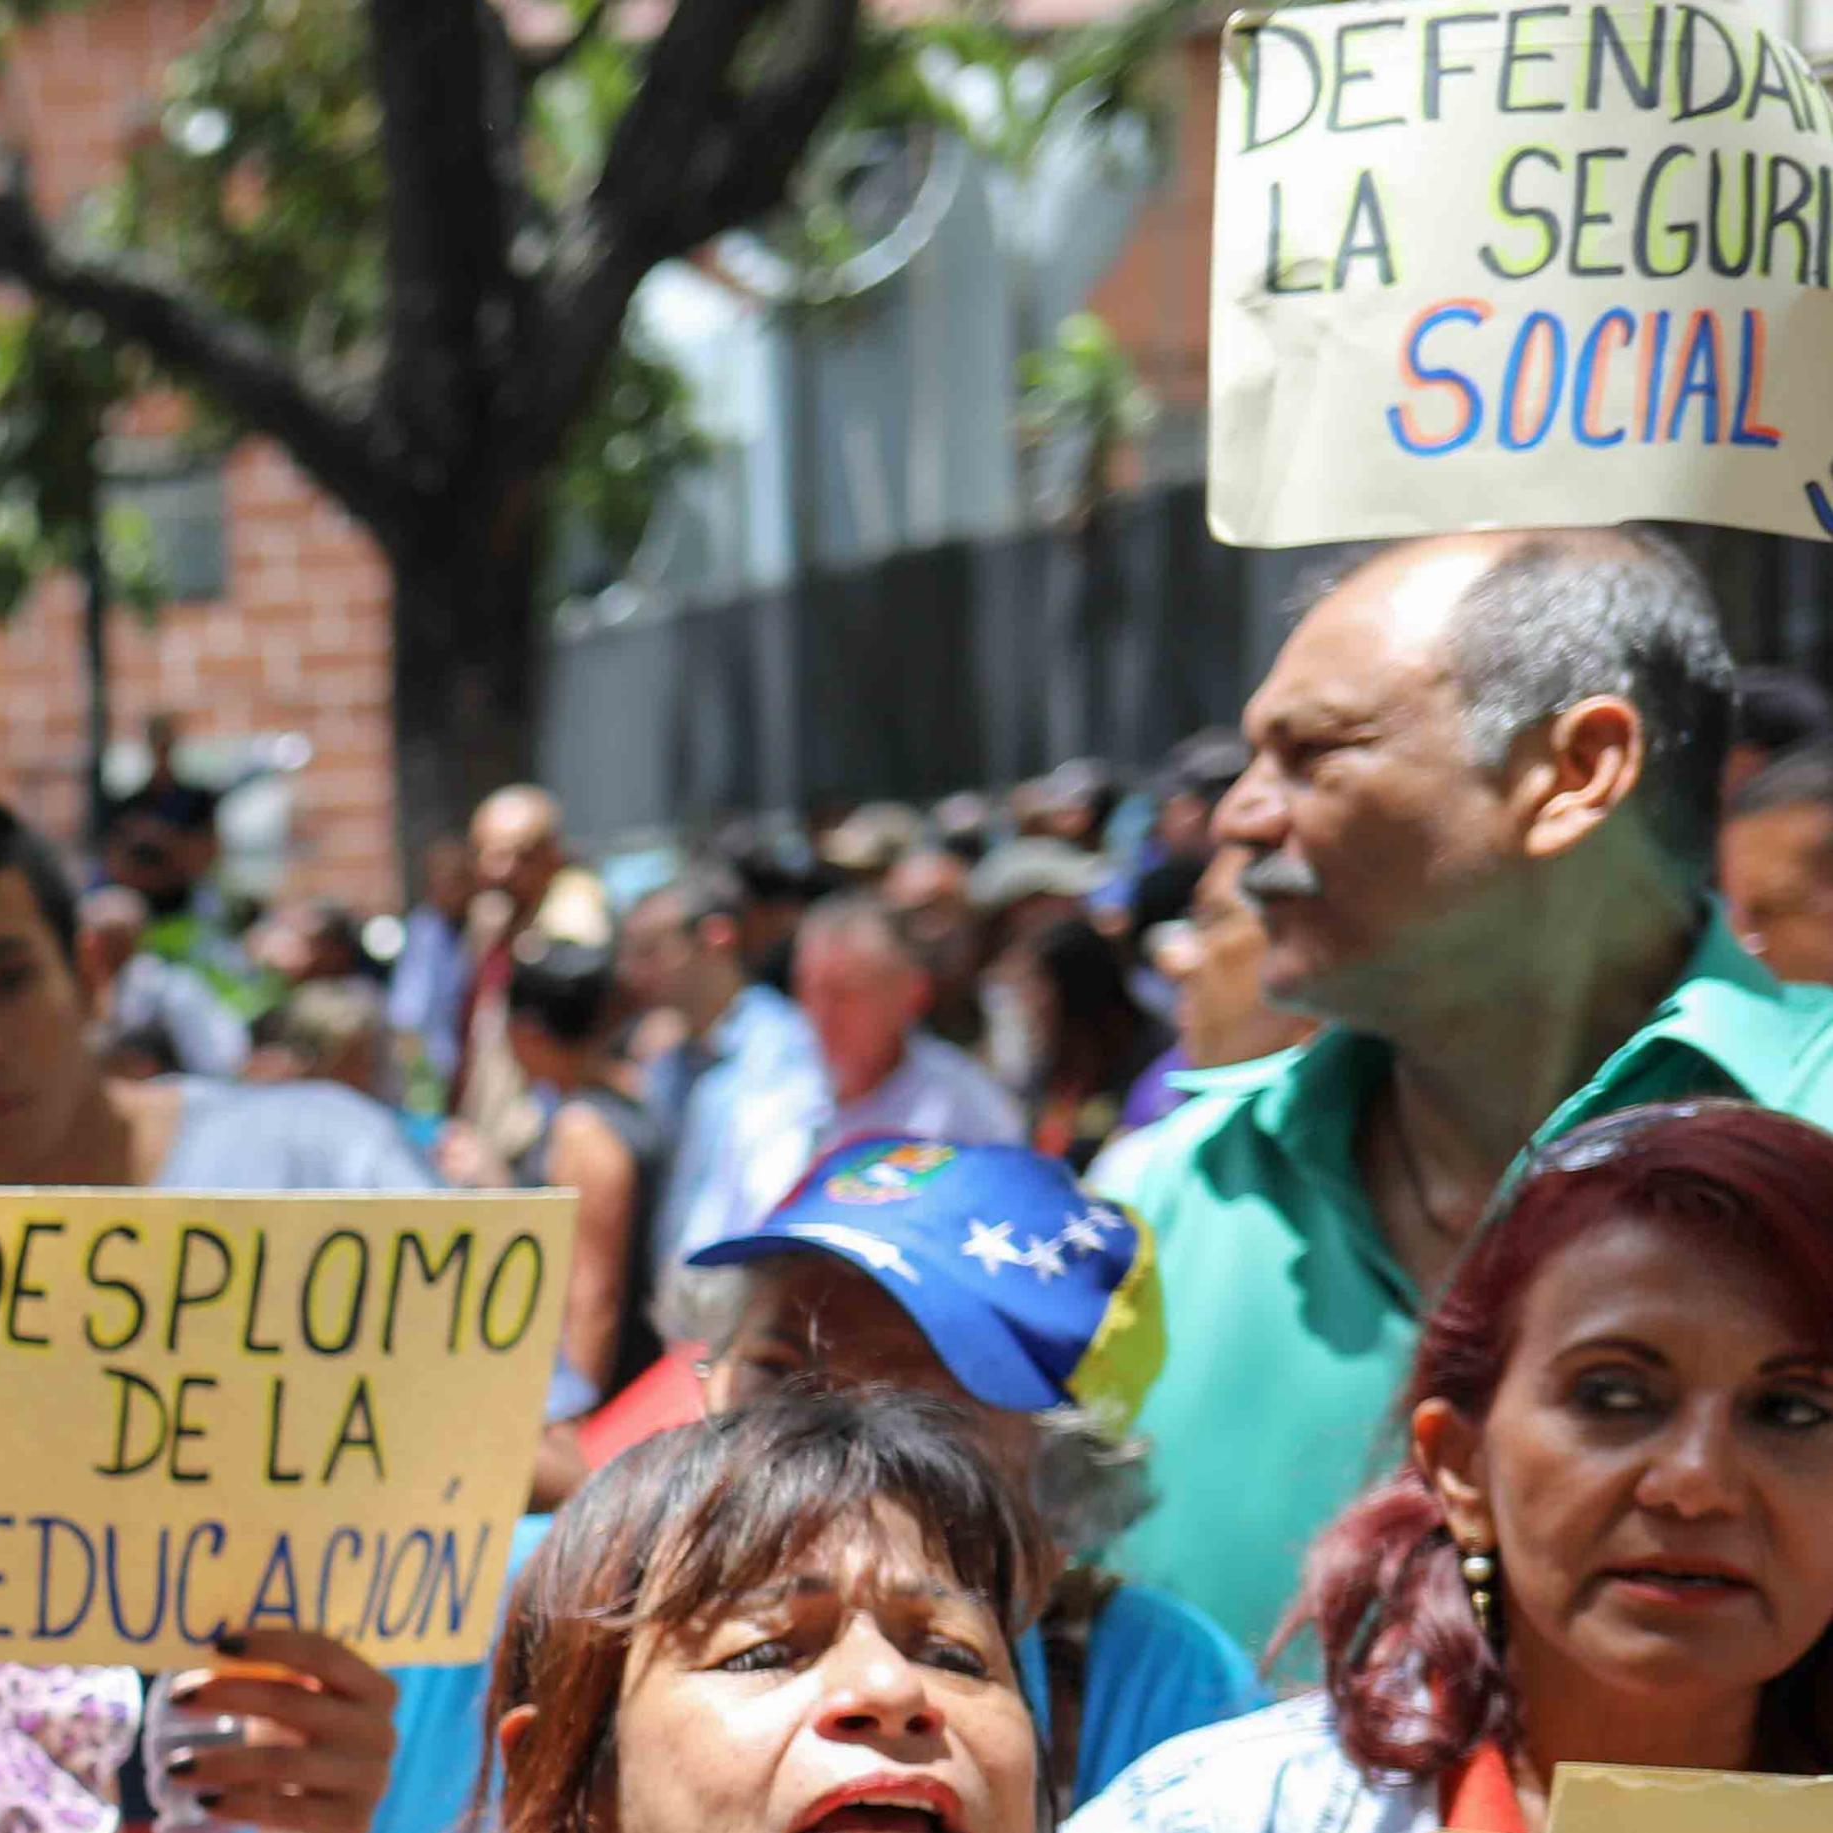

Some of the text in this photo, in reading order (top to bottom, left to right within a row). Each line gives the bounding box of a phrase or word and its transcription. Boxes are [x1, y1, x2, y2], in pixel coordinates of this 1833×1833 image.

[1266, 170, 1398, 294] LA
[1386, 298, 1784, 457] SOCIAL
[94, 1369, 386, 1485] DE LA
